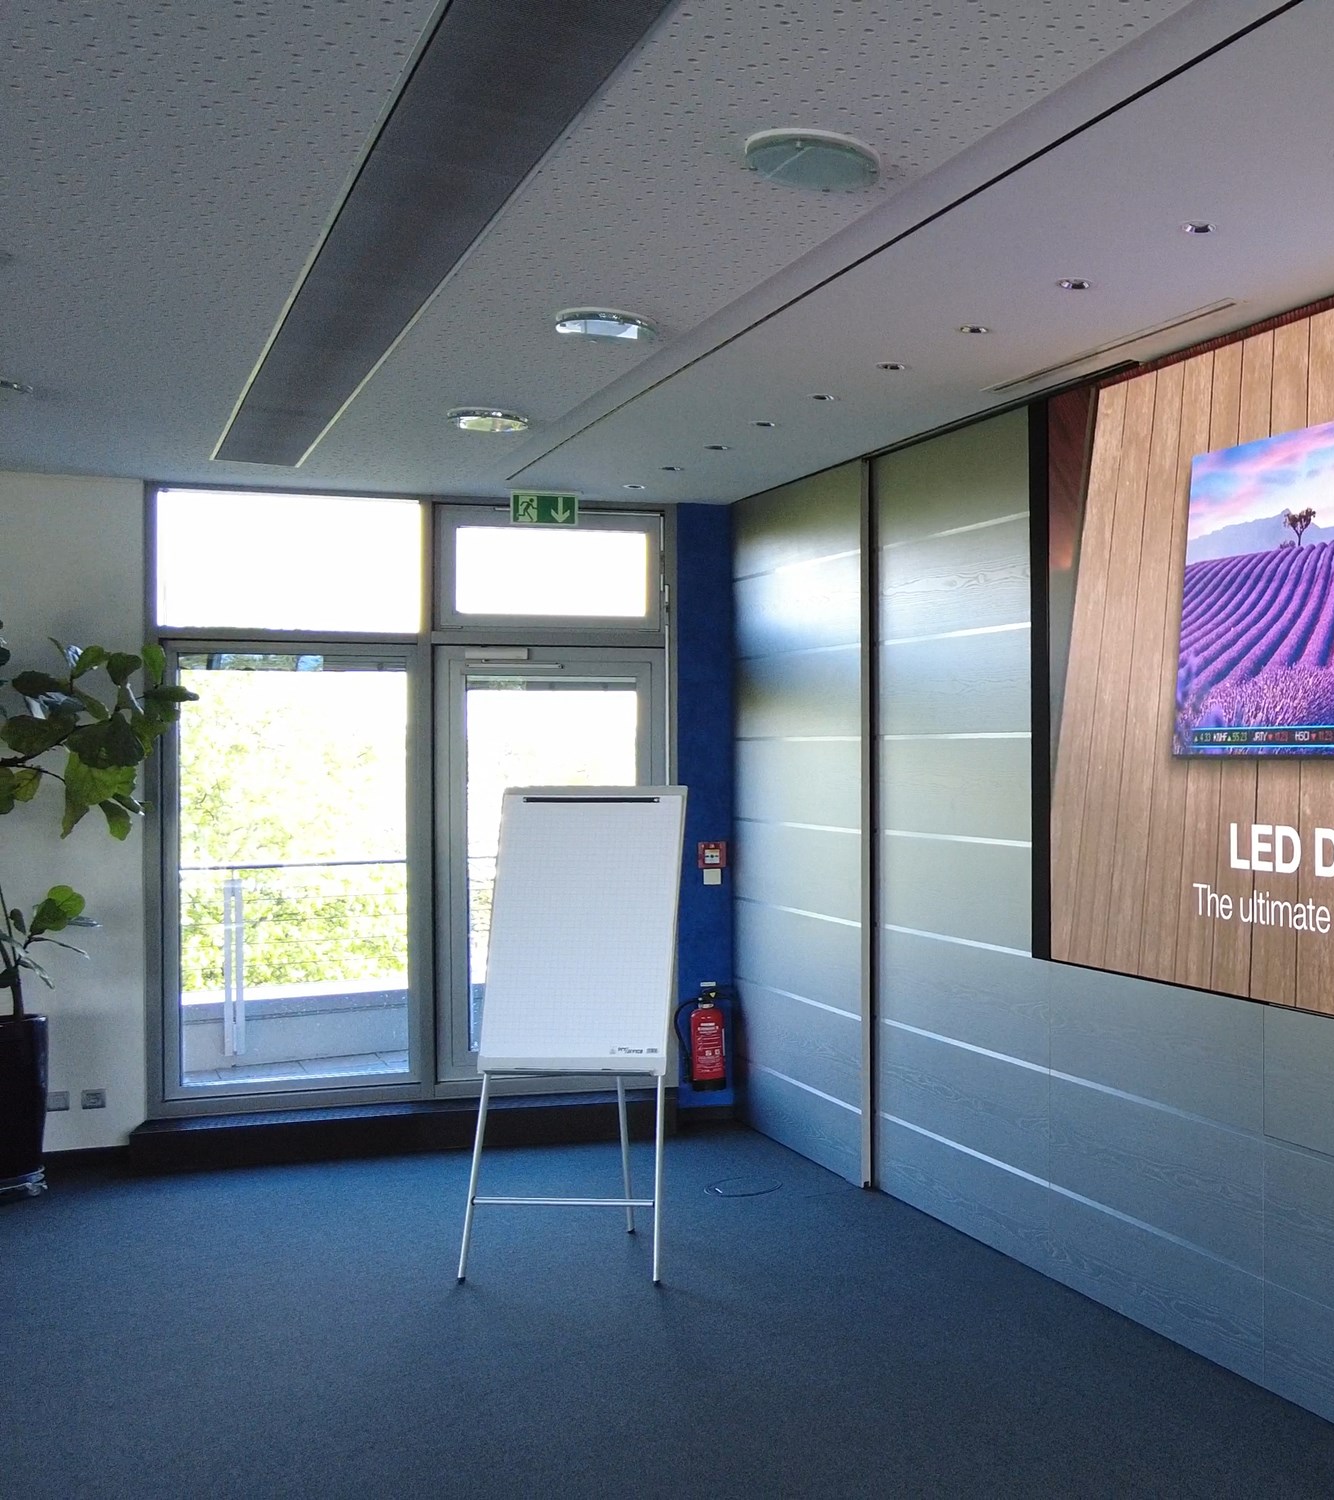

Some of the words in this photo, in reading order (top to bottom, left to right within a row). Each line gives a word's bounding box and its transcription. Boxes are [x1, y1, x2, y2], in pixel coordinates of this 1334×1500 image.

[1229, 822, 1301, 874] LED
[1193, 882, 1233, 920] The
[1239, 889, 1331, 934] ultimate
